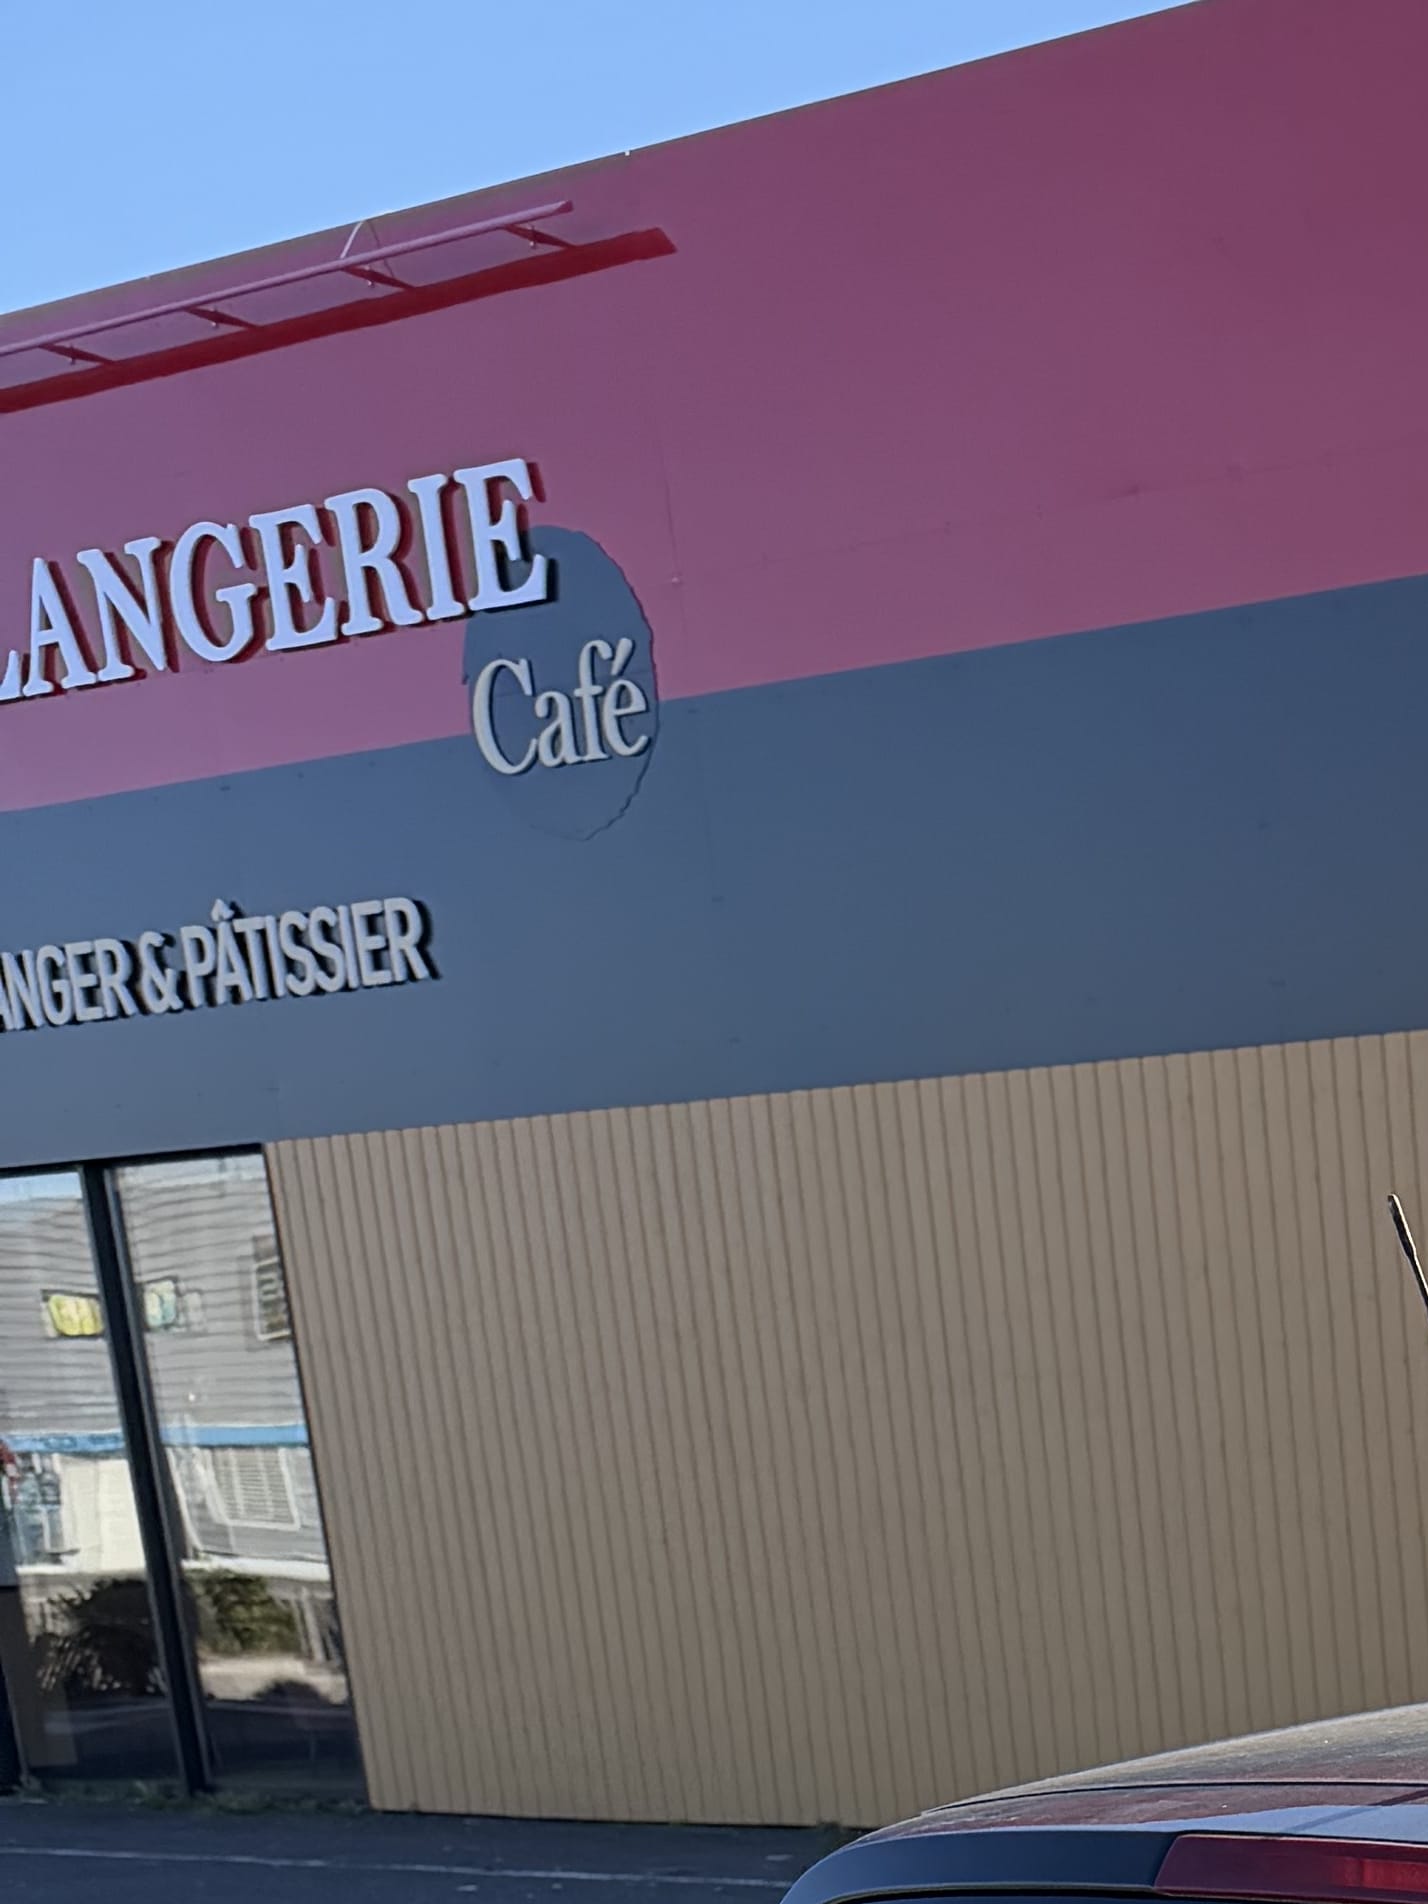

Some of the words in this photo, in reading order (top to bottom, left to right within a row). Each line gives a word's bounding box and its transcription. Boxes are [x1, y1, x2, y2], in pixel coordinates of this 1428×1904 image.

[0, 457, 549, 701] ANGERIE
[472, 637, 650, 775] Café
[0, 937, 138, 1031] NGER
[138, 930, 184, 1015] &
[180, 897, 431, 1009] PÂTISSIER
